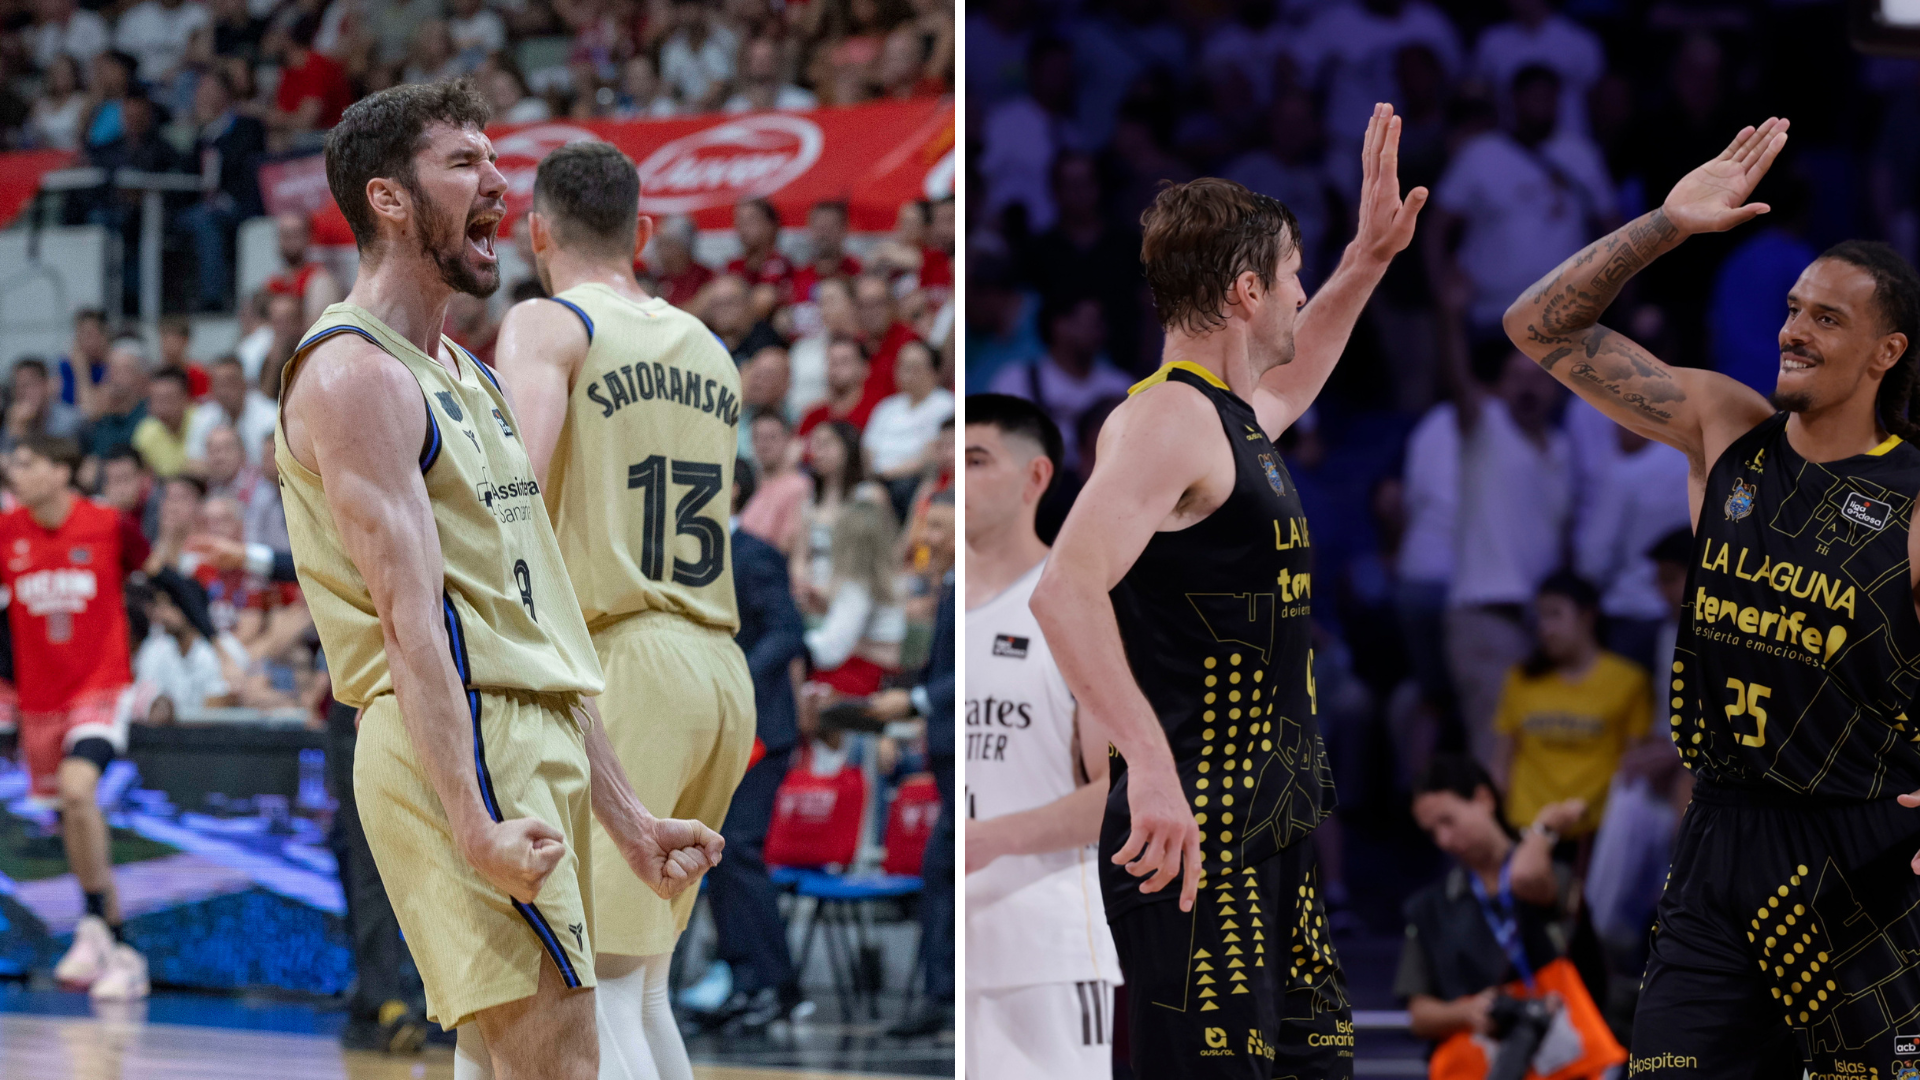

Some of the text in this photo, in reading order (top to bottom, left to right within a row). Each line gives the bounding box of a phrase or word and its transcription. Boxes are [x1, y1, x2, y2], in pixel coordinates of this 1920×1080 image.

[1847, 507, 1882, 527] endesa
[1850, 500, 1867, 513] liga
[628, 455, 725, 588] 13
[1701, 537, 1856, 620] LA LAGUNA
[1695, 625, 1820, 668] esierta emociones
[965, 694, 1032, 729] ates
[1724, 677, 1772, 748] 25
[1200, 1049, 1235, 1057] austral
[1896, 1043, 1916, 1052] acb
[1633, 1052, 1698, 1076] Hospiten
[1834, 1058, 1867, 1074] Islas
